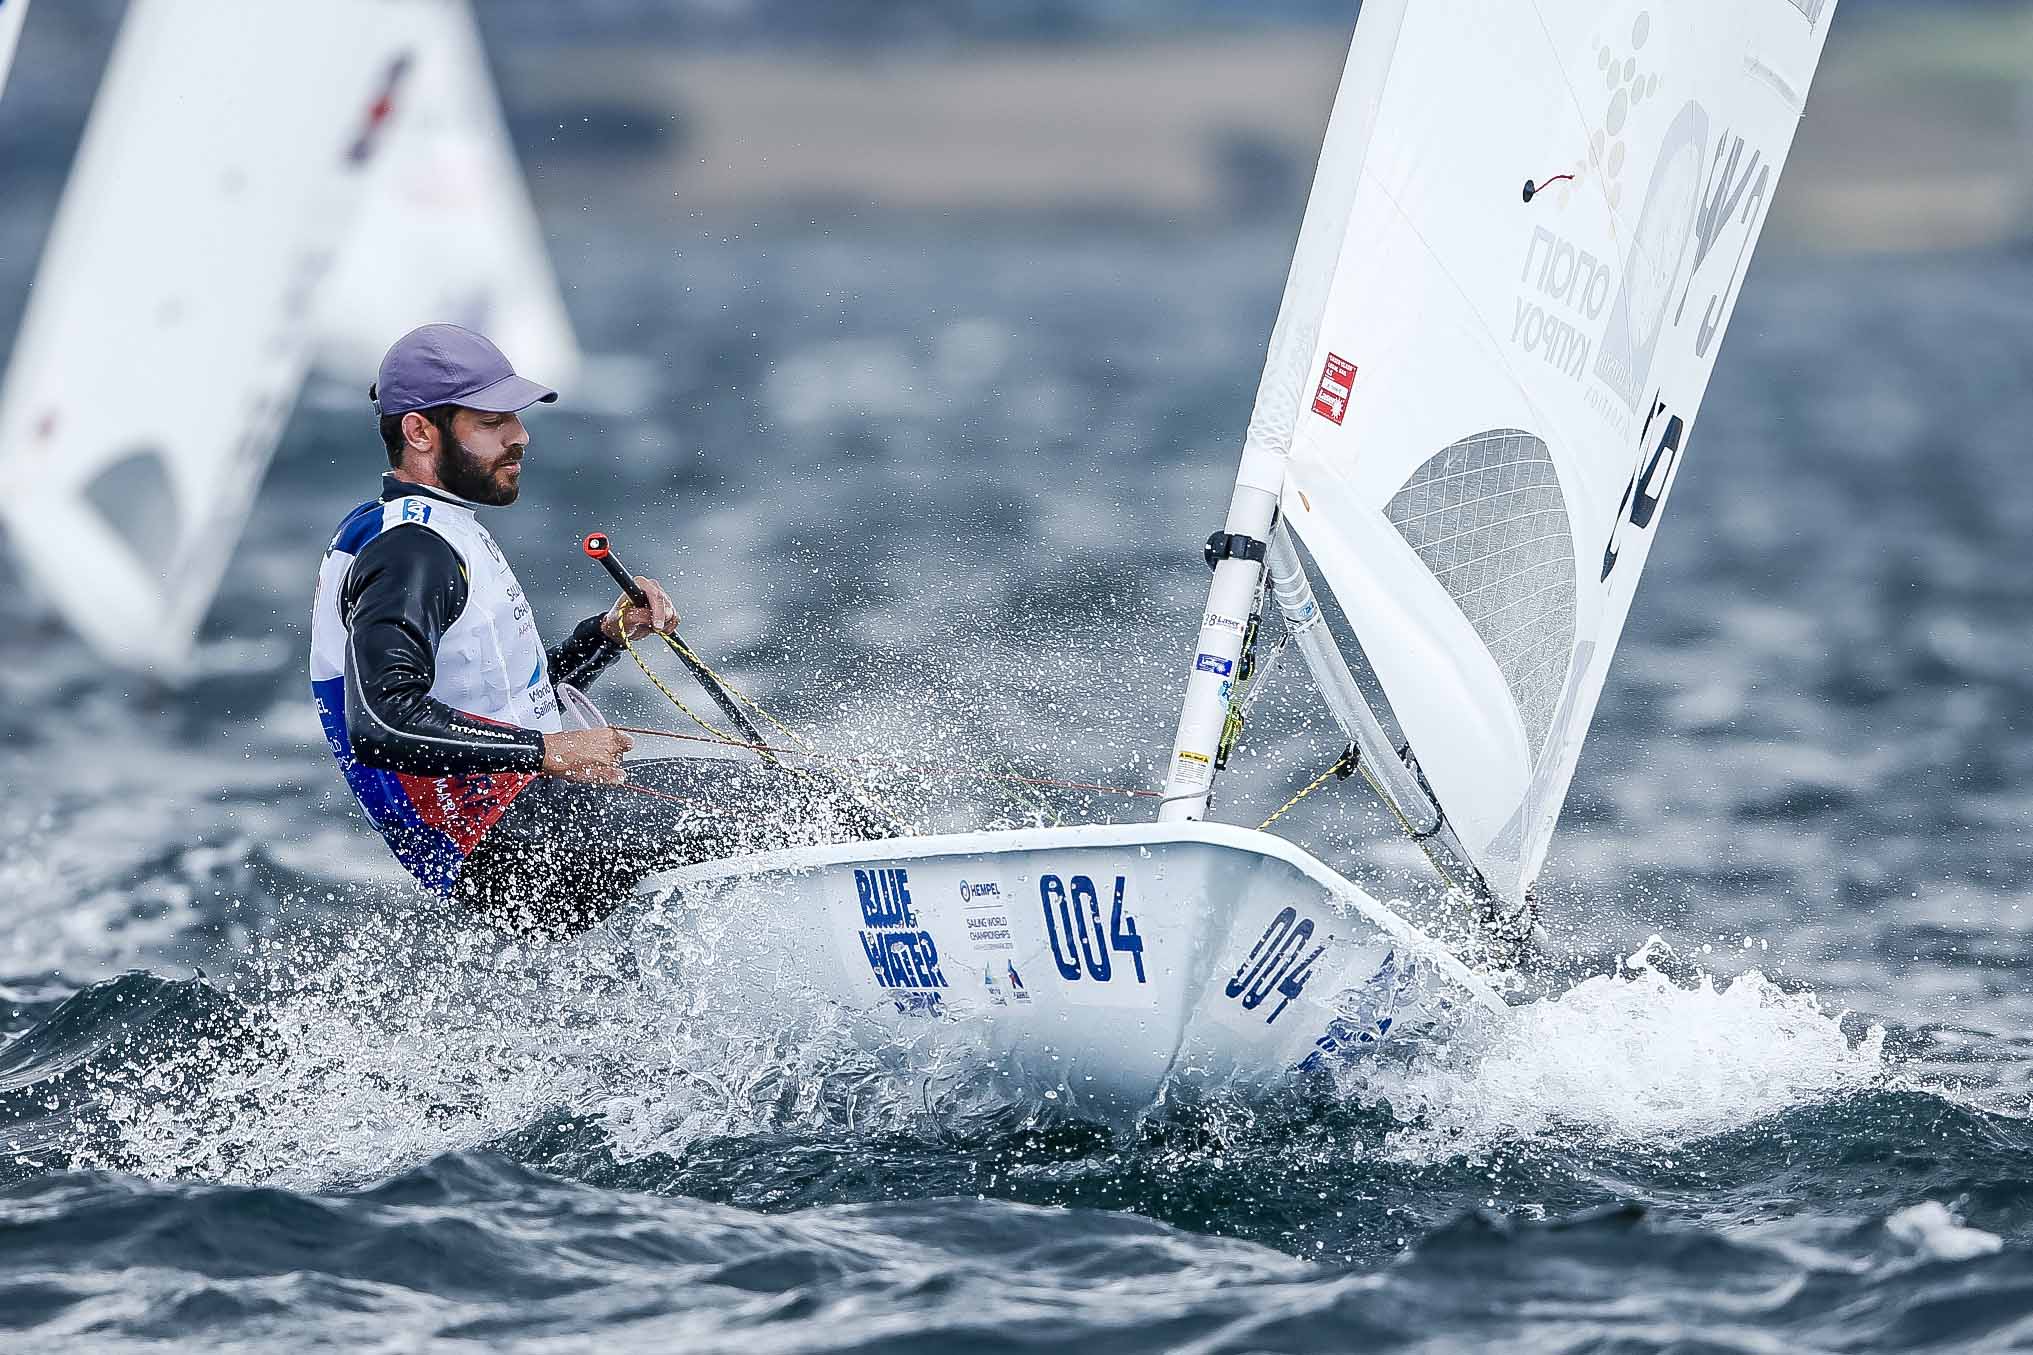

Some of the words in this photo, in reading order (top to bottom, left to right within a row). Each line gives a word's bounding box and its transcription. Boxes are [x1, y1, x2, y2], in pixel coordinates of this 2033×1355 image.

[528, 682, 552, 703] World
[533, 699, 558, 720] Sailing
[449, 723, 515, 740] TITANIUM
[970, 882, 1001, 897] HEMPEL
[1039, 874, 1147, 984] 004
[1225, 906, 1335, 1025] 004
